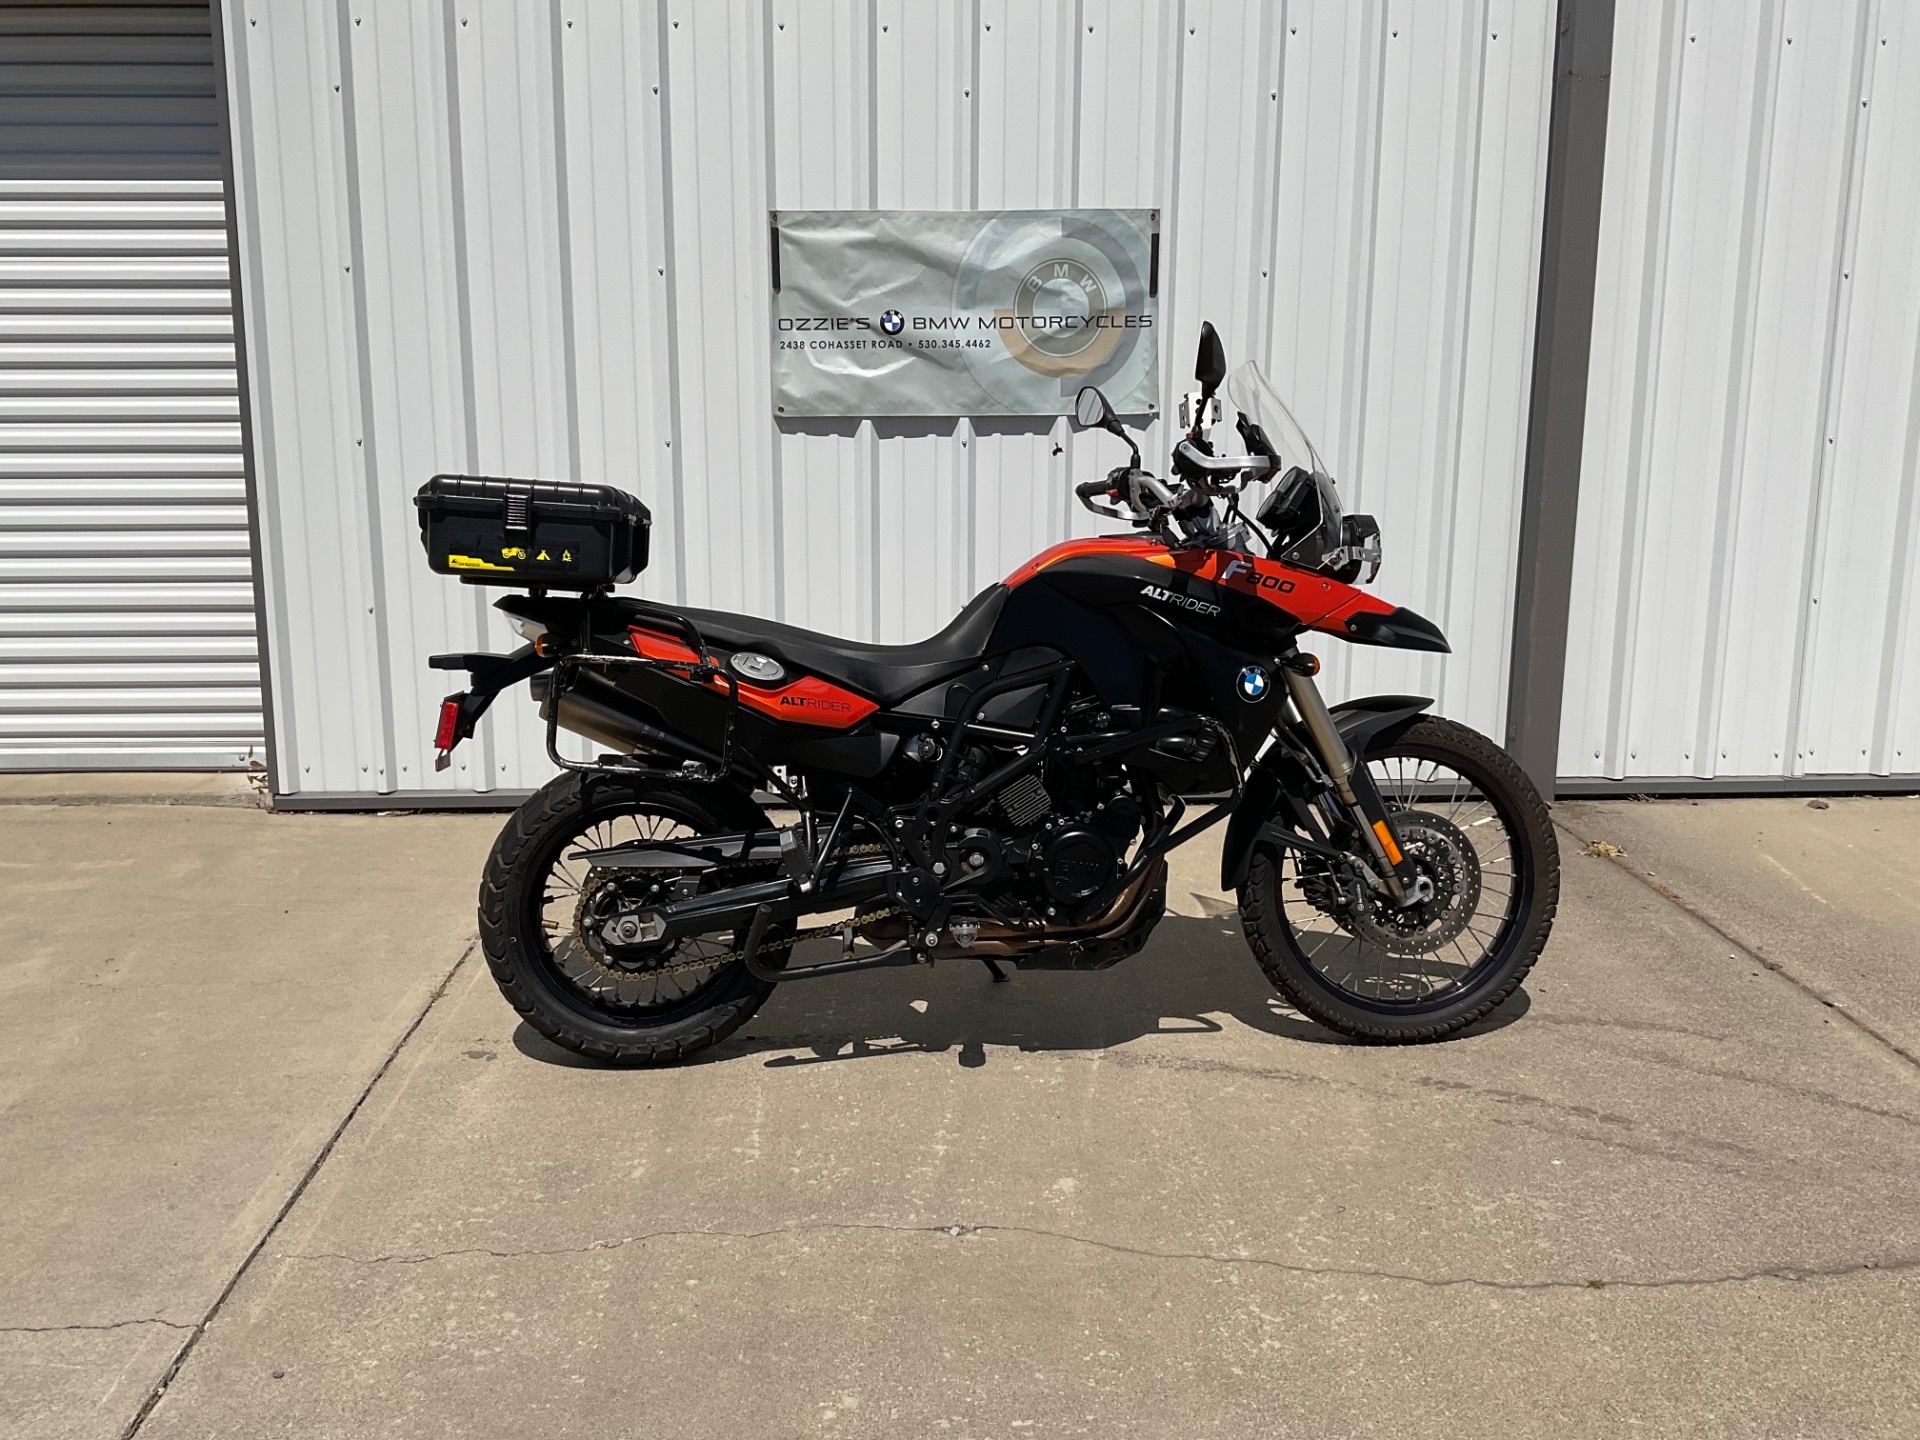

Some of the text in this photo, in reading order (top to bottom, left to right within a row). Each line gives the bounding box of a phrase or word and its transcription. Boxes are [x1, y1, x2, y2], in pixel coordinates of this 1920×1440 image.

[1027, 264, 1097, 293] BMW
[778, 314, 1153, 331] OZZIE'S BMW MOTORCYCLES
[779, 339, 991, 350] 2438 COHASSET ROAD 530.345.4462
[779, 695, 852, 712] ALTRIDER
